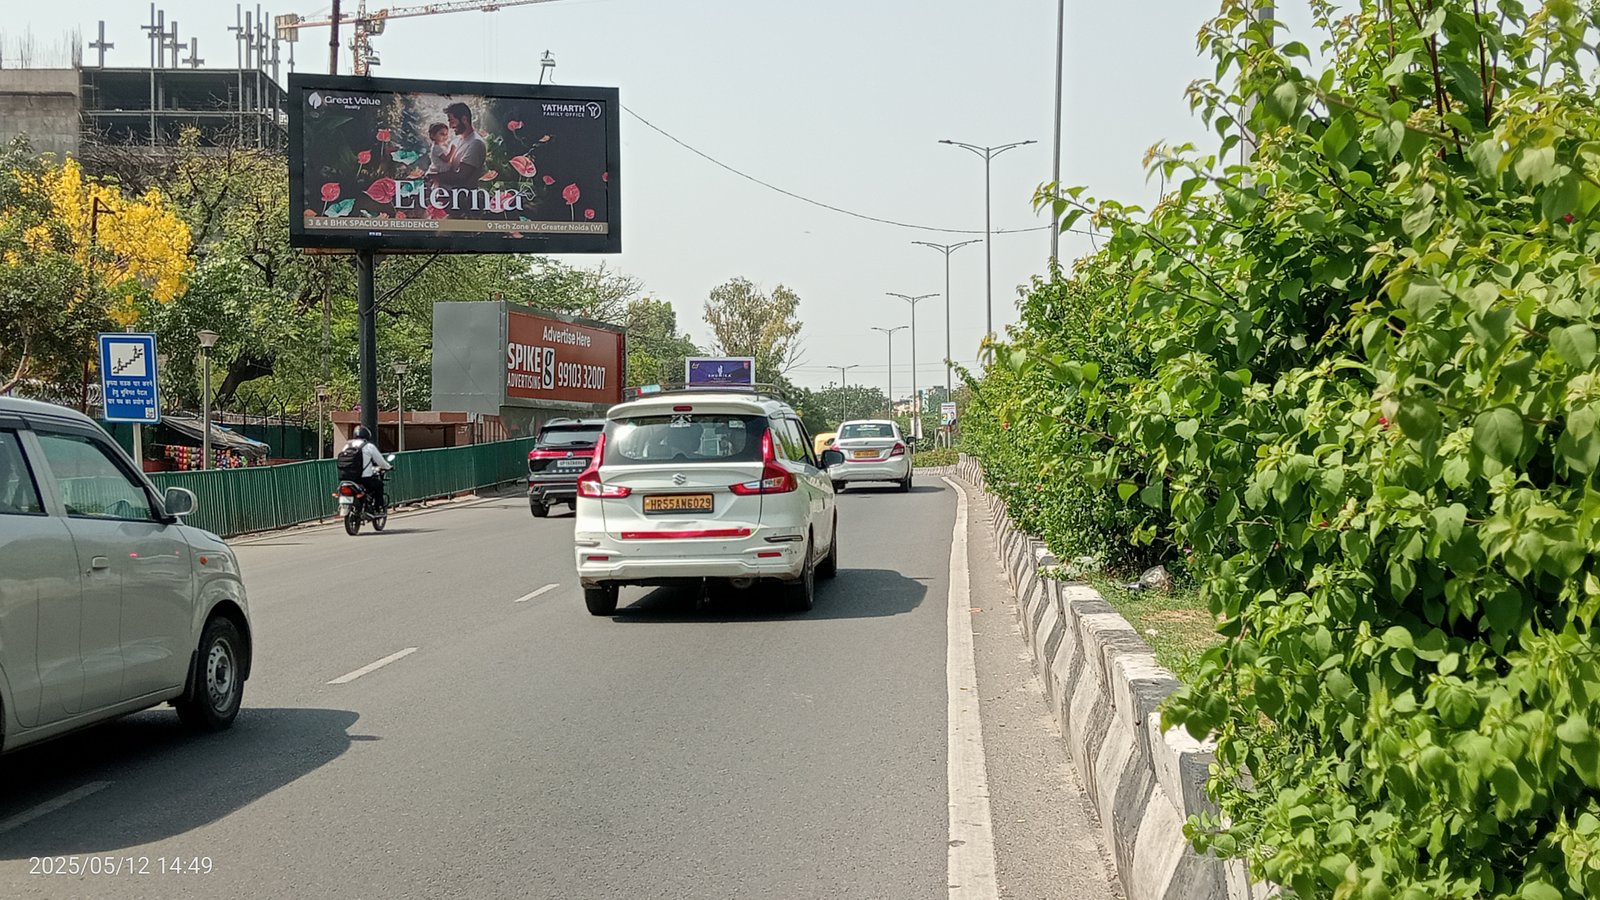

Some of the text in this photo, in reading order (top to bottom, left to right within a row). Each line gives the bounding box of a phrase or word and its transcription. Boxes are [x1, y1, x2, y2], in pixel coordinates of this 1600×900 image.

[324, 95, 381, 105] Great Value
[541, 103, 585, 112] YATHARTH
[393, 179, 524, 211] Eternia
[330, 219, 348, 227] BHK
[349, 219, 389, 228] SPACIOUS
[390, 220, 440, 229] RESIDENCES
[541, 223, 567, 231] Greater
[568, 224, 589, 232] Noida
[542, 326, 592, 348] Advertise Here
[507, 342, 542, 373] SPIKE
[507, 372, 541, 390] ADVERTISING
[558, 361, 606, 390] 99103 32007
[650, 497, 712, 510] HR55AN6029
